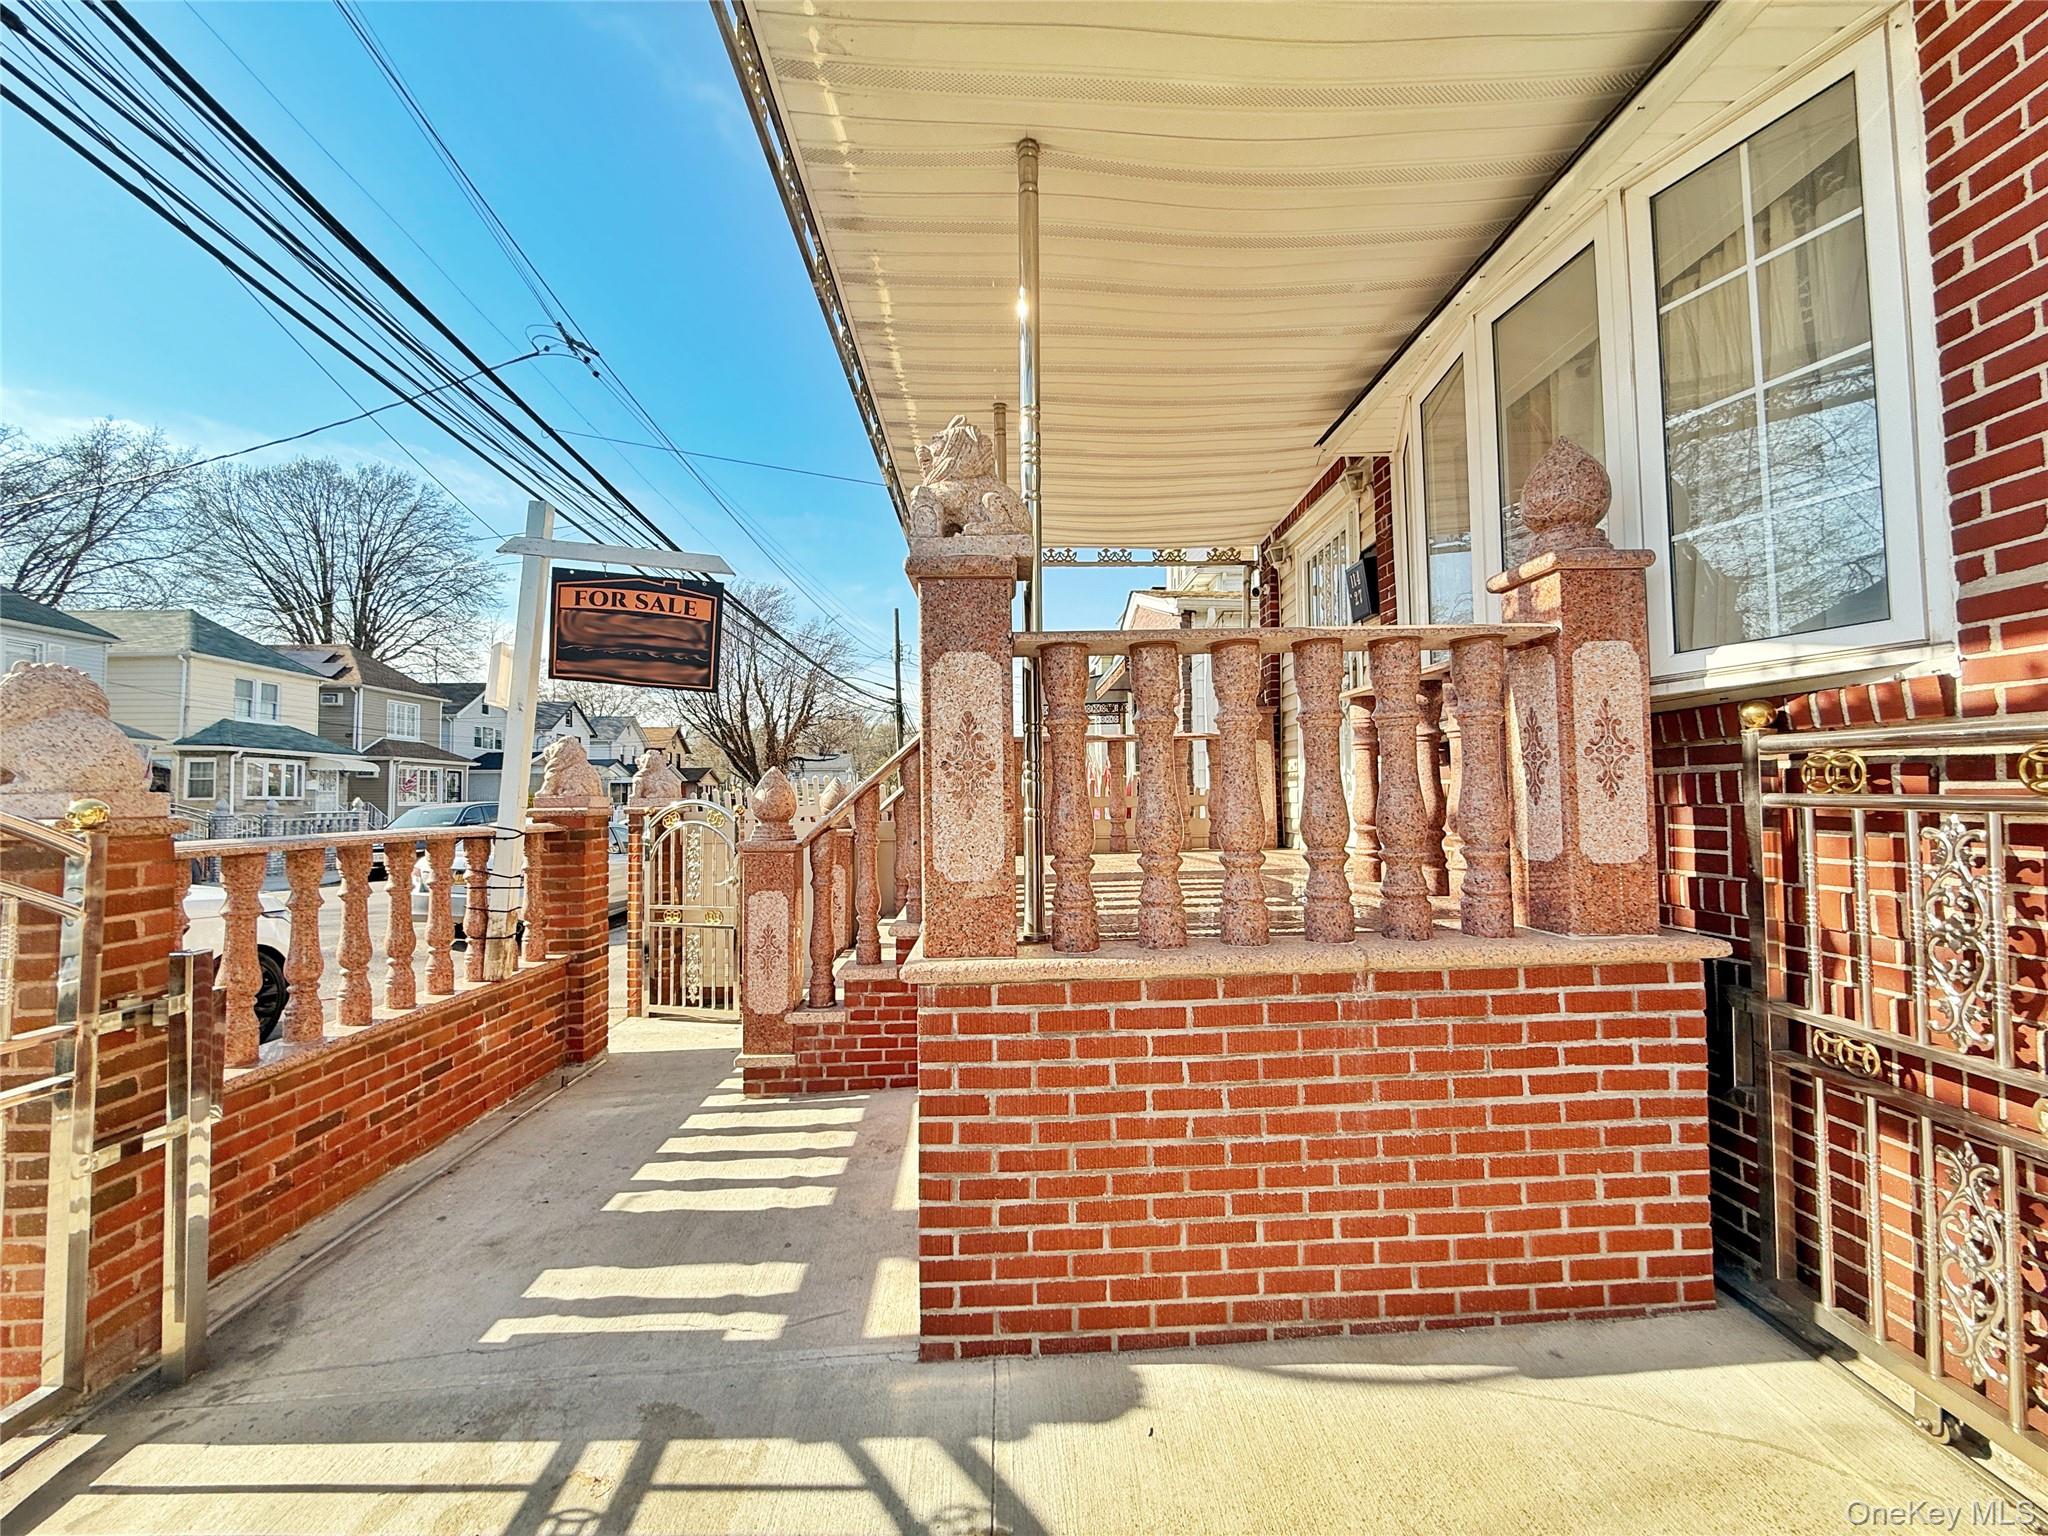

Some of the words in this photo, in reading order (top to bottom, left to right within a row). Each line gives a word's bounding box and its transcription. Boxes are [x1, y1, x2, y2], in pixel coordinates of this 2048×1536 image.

[1349, 570, 1361, 588] 114
[574, 590, 628, 608] FOR
[635, 593, 698, 617] SALE
